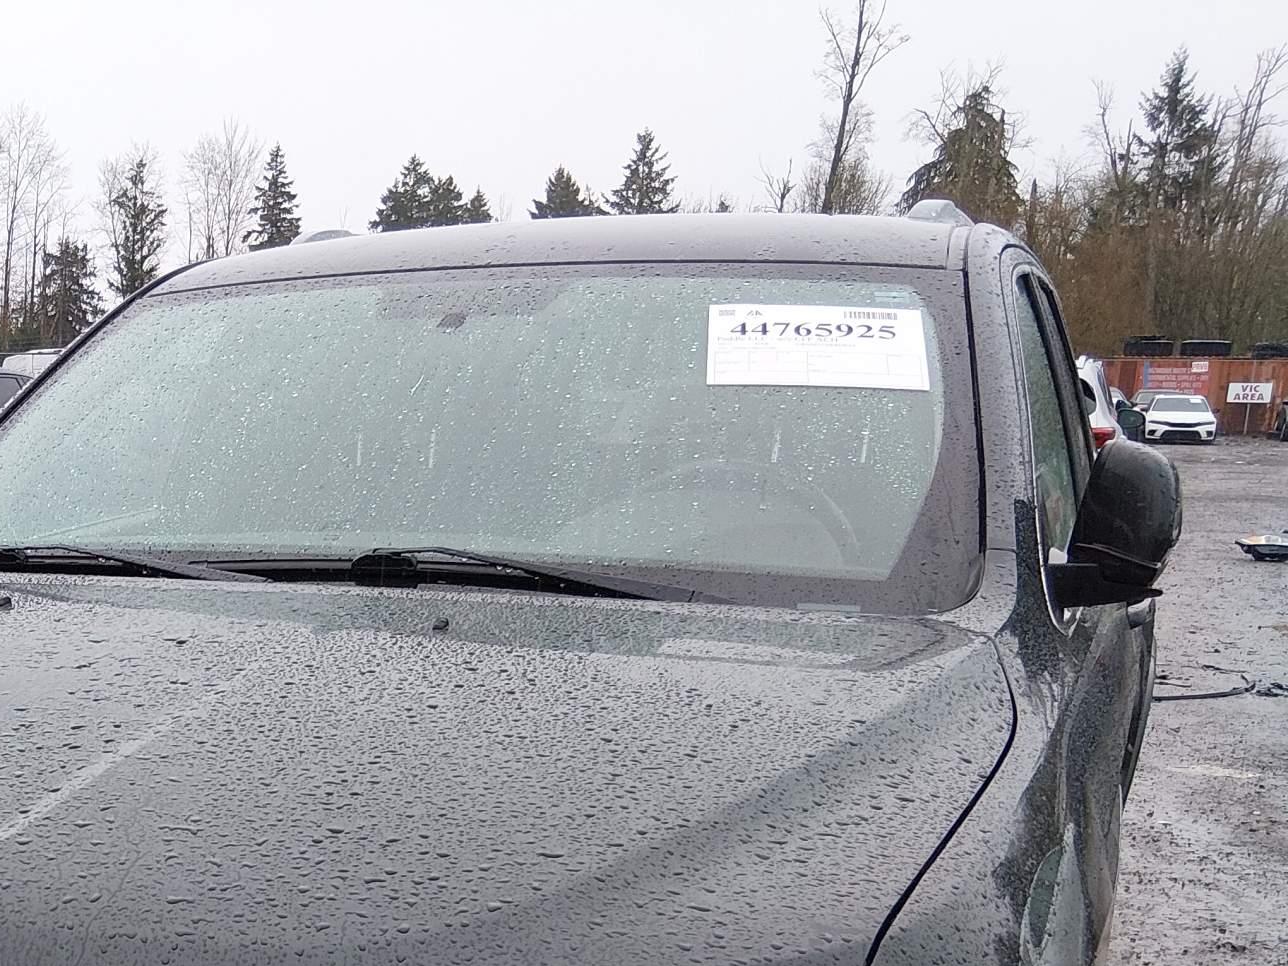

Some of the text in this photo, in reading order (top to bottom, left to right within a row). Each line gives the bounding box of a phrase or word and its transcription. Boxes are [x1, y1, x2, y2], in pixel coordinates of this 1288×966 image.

[730, 321, 897, 340] 44765925
[1241, 384, 1260, 393] VIC
[1233, 392, 1264, 401] AREA
